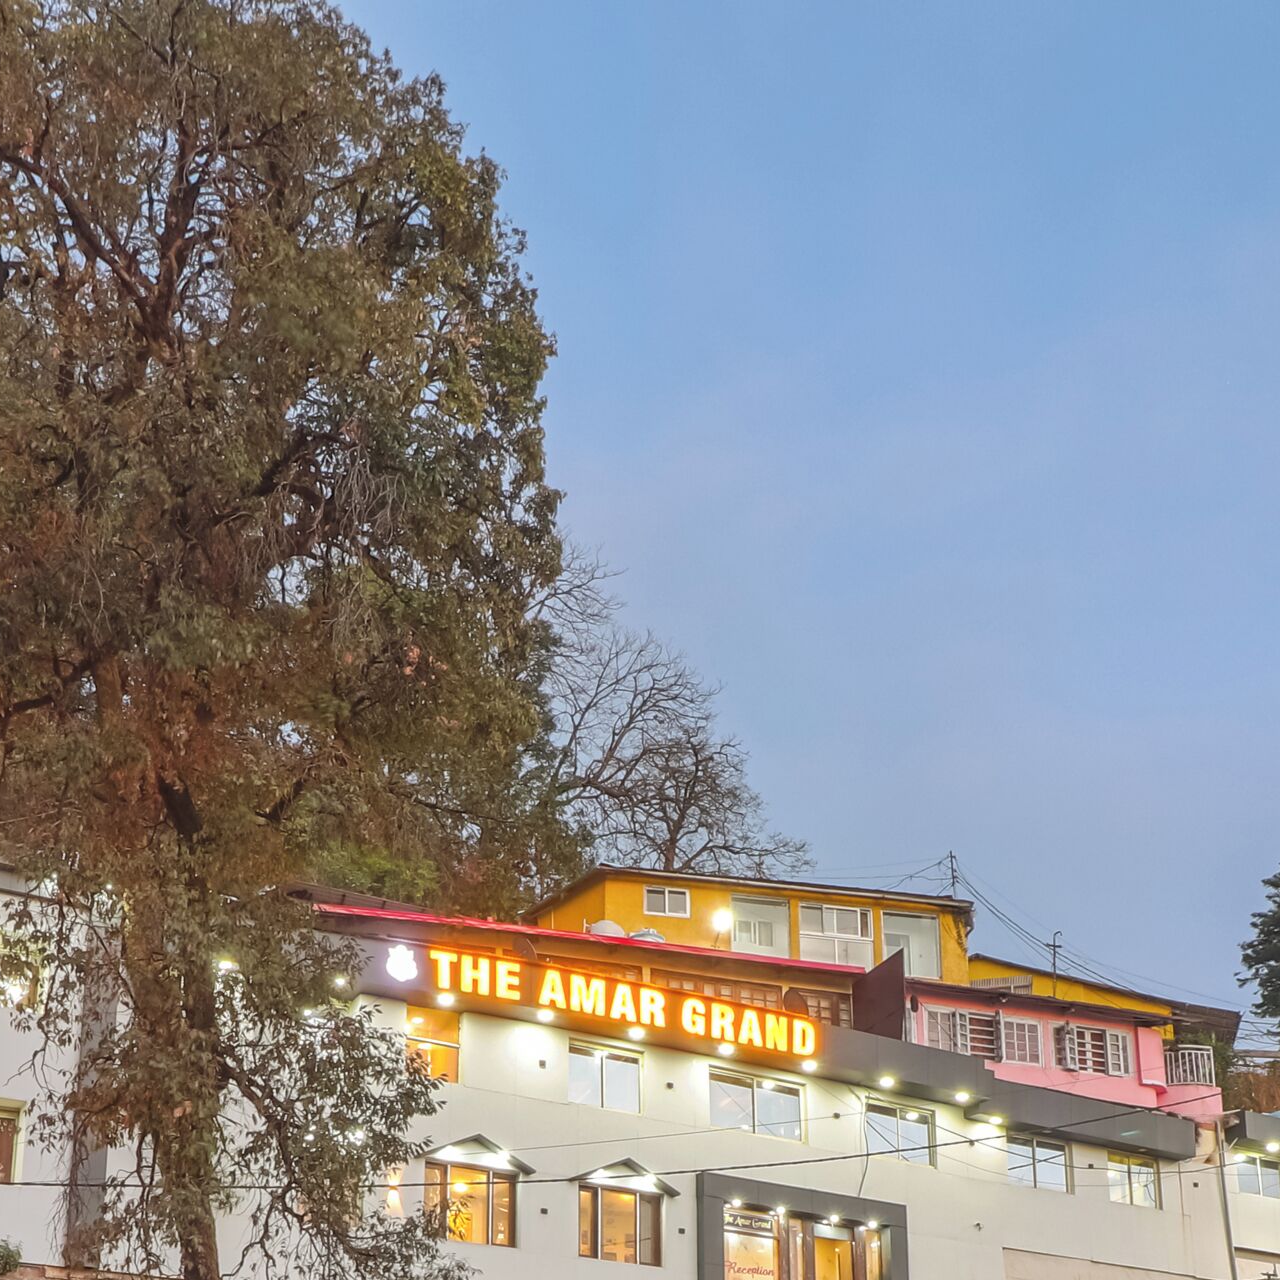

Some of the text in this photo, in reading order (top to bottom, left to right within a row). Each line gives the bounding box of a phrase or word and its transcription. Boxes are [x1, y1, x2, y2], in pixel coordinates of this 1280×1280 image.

[429, 949, 817, 1056] THE AMAR GRAND
[724, 1260, 774, 1279] Reception
